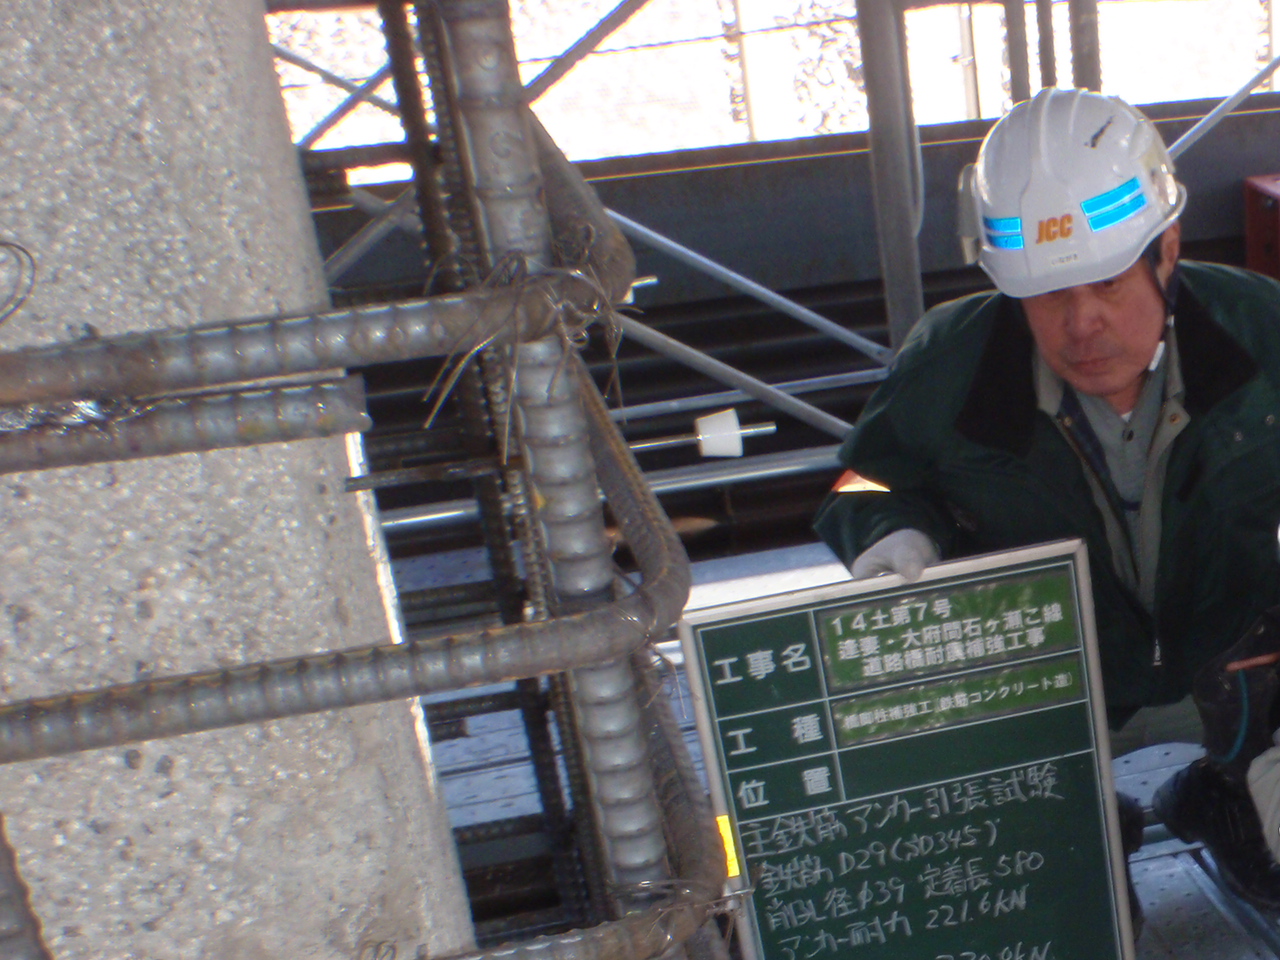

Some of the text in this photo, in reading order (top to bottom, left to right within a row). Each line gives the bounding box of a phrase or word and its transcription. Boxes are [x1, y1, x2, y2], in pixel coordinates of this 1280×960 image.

[1036, 213, 1074, 244] JCC
[713, 643, 812, 686] 工事名
